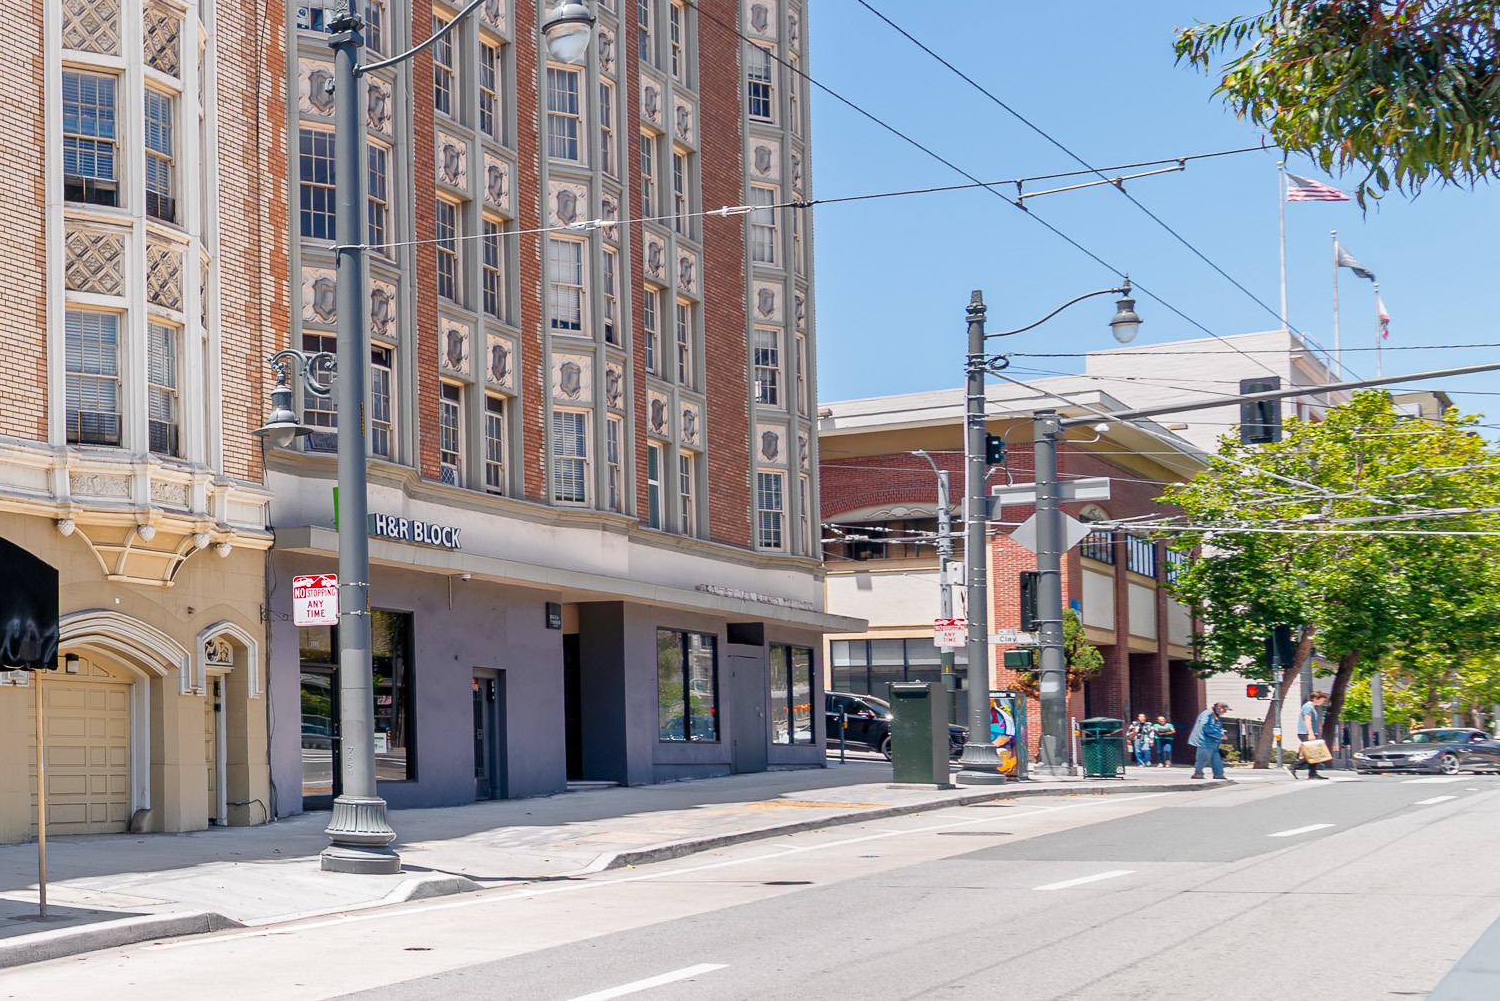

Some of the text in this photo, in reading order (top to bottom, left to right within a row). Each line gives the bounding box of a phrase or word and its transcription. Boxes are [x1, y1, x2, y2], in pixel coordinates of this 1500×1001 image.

[376, 513, 461, 548] H&R BLOCK
[294, 588, 335, 598] NO STOPPING
[308, 600, 323, 608] ANY
[307, 609, 325, 617] TIME
